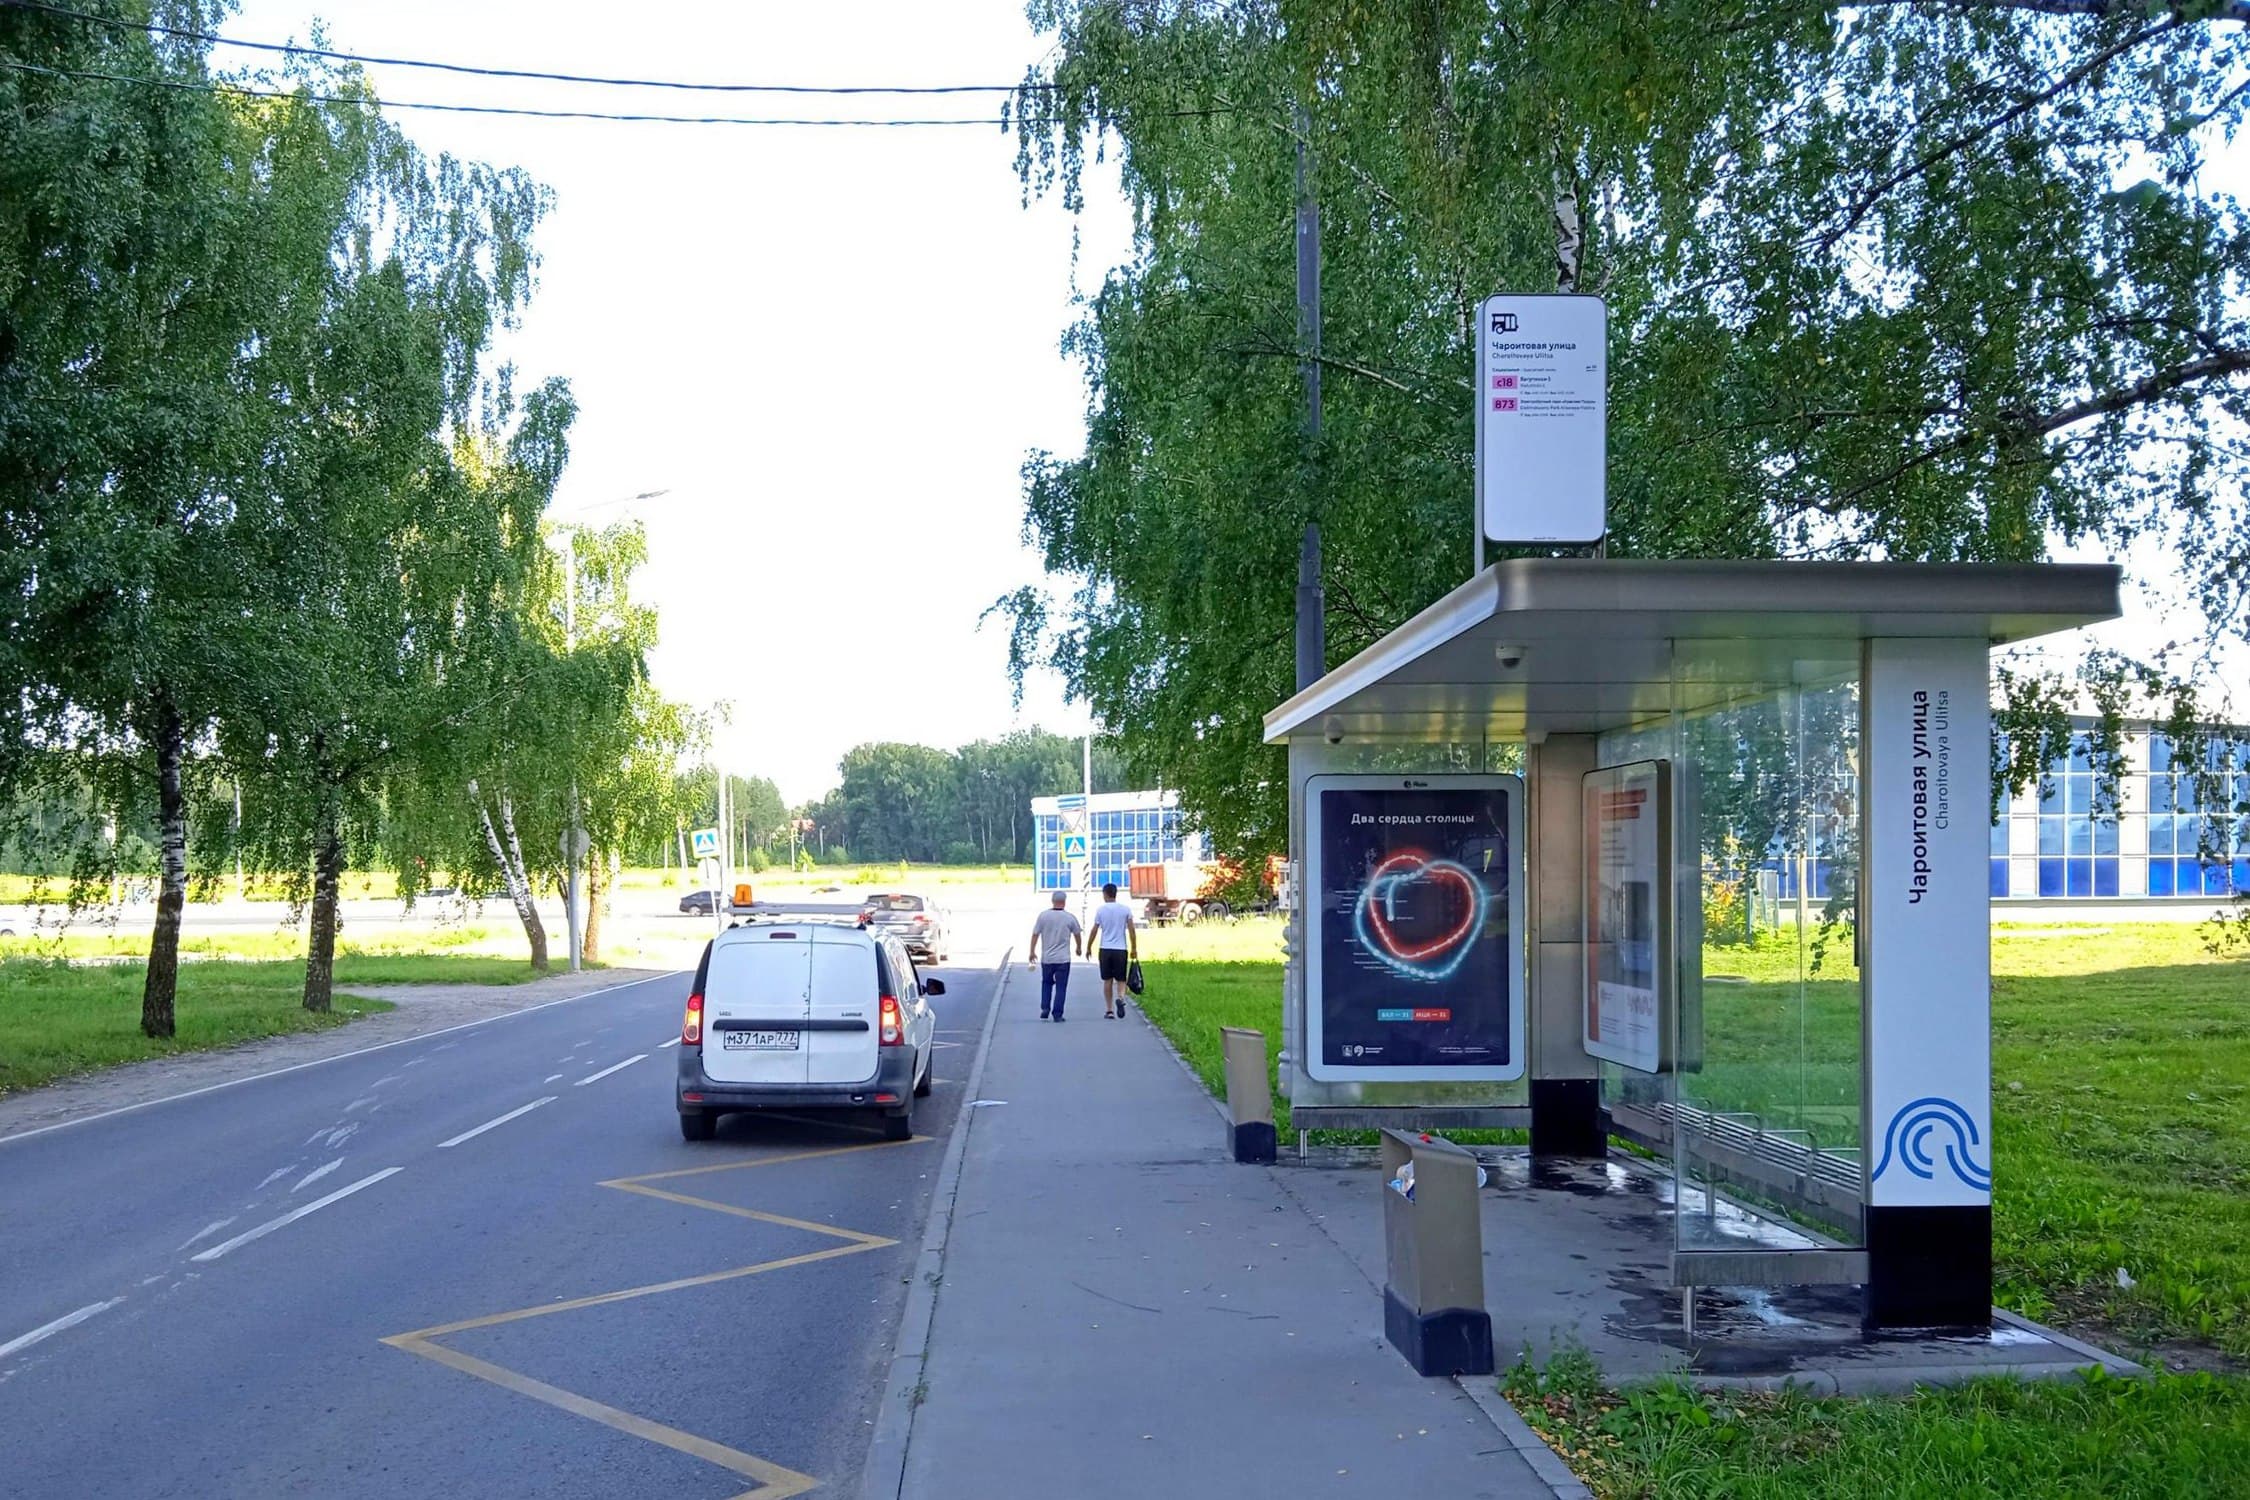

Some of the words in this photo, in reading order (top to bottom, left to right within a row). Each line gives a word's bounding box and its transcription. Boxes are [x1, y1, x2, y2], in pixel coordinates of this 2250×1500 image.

[1492, 341, 1547, 351] Чароитовая
[1548, 343, 1576, 351] улица
[1495, 399, 1515, 410] 873
[1912, 690, 1932, 759] улица
[1935, 690, 1949, 731] Ulitsa
[1935, 735, 1951, 830] Charoitovaya
[1350, 813, 1375, 825] Два
[1378, 815, 1422, 825] сердца
[1424, 815, 1475, 824] столицы
[1908, 765, 1932, 904] Чароитовая
